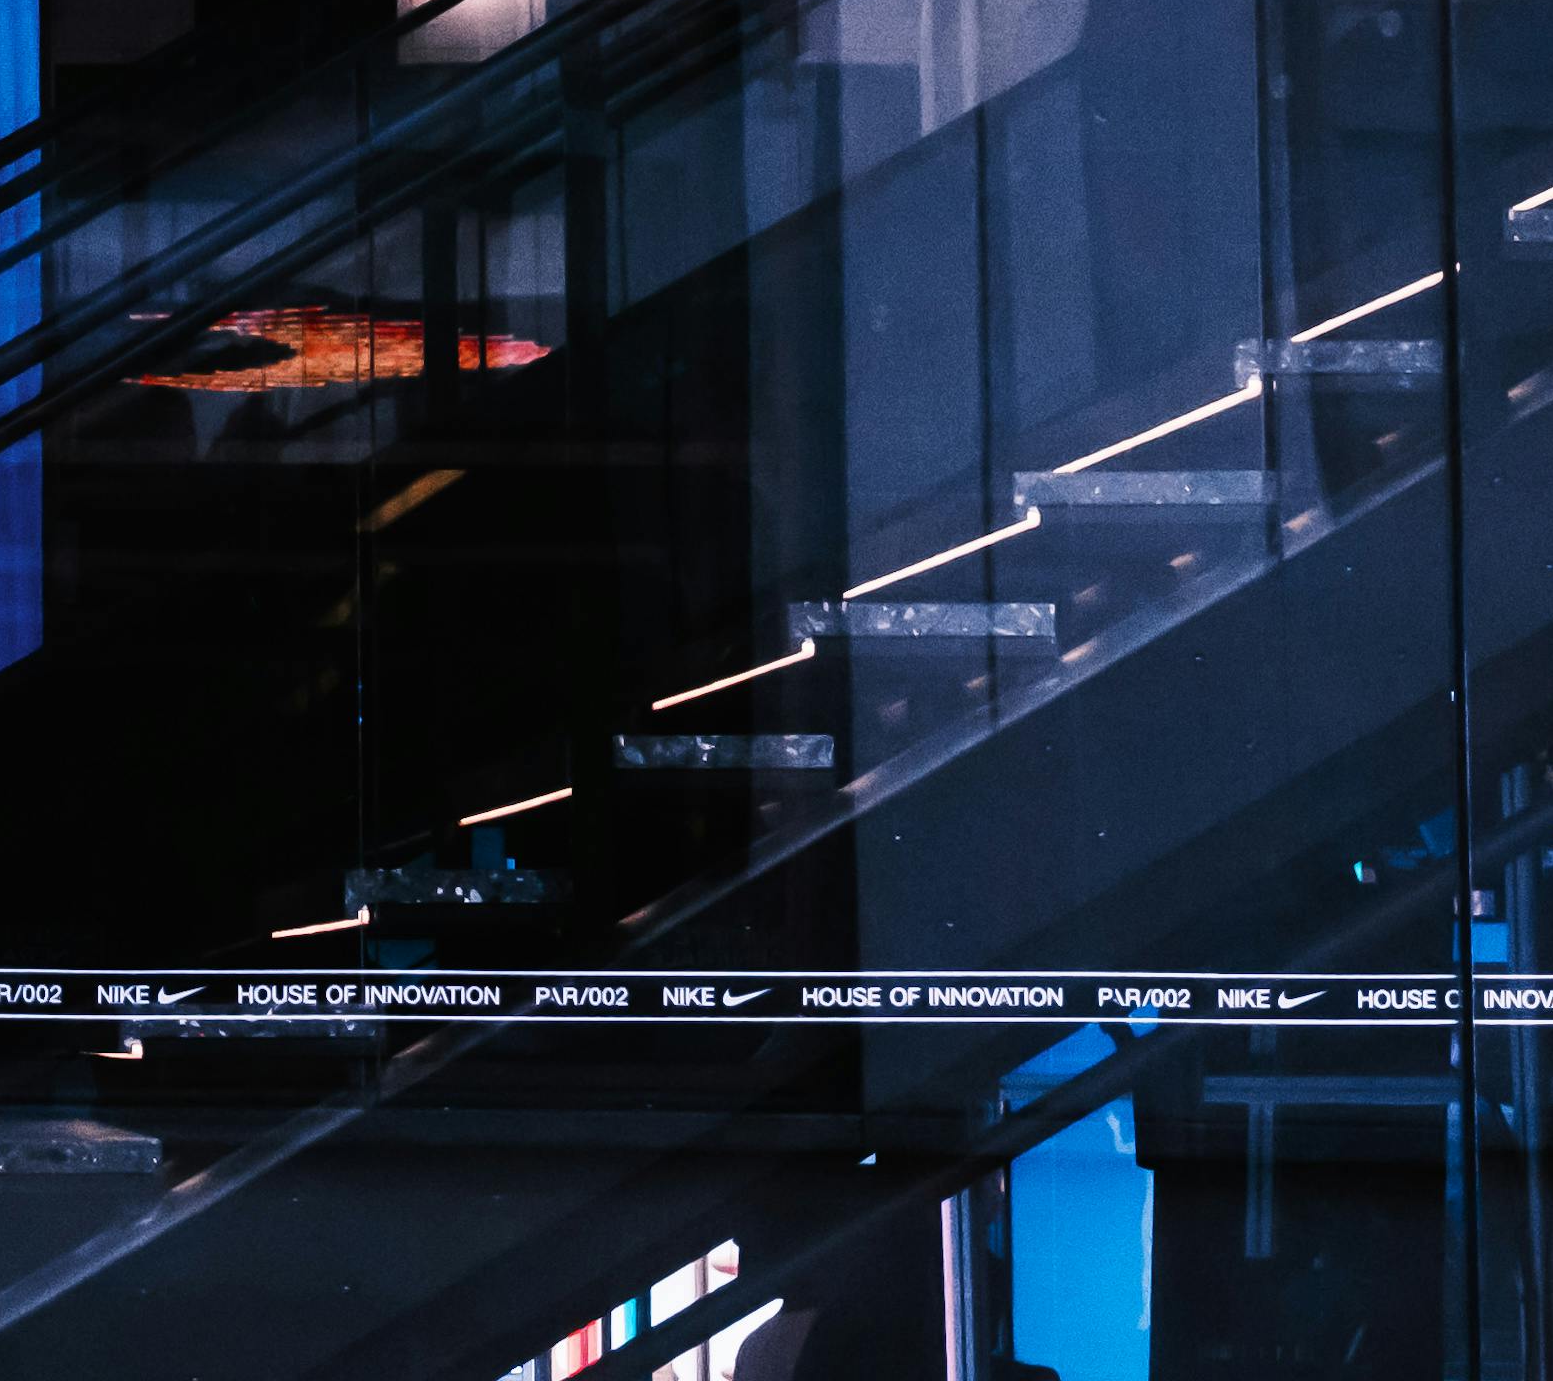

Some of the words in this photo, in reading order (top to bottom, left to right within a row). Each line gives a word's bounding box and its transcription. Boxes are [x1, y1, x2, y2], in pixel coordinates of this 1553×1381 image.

[98, 984, 149, 1005] NIKE
[238, 984, 316, 1005] HOUSE
[326, 985, 357, 1007] OF
[365, 985, 499, 1006] INNOVATION
[536, 986, 628, 1007] PAR/002
[663, 986, 715, 1007] NIKE
[803, 986, 881, 1007] HOUSE
[890, 986, 921, 1007] OF
[929, 986, 1063, 1007] INNOVATION
[1098, 987, 1190, 1009] PAR/002
[1218, 988, 1270, 1009] NIKE
[1358, 988, 1436, 1010] HOUSE
